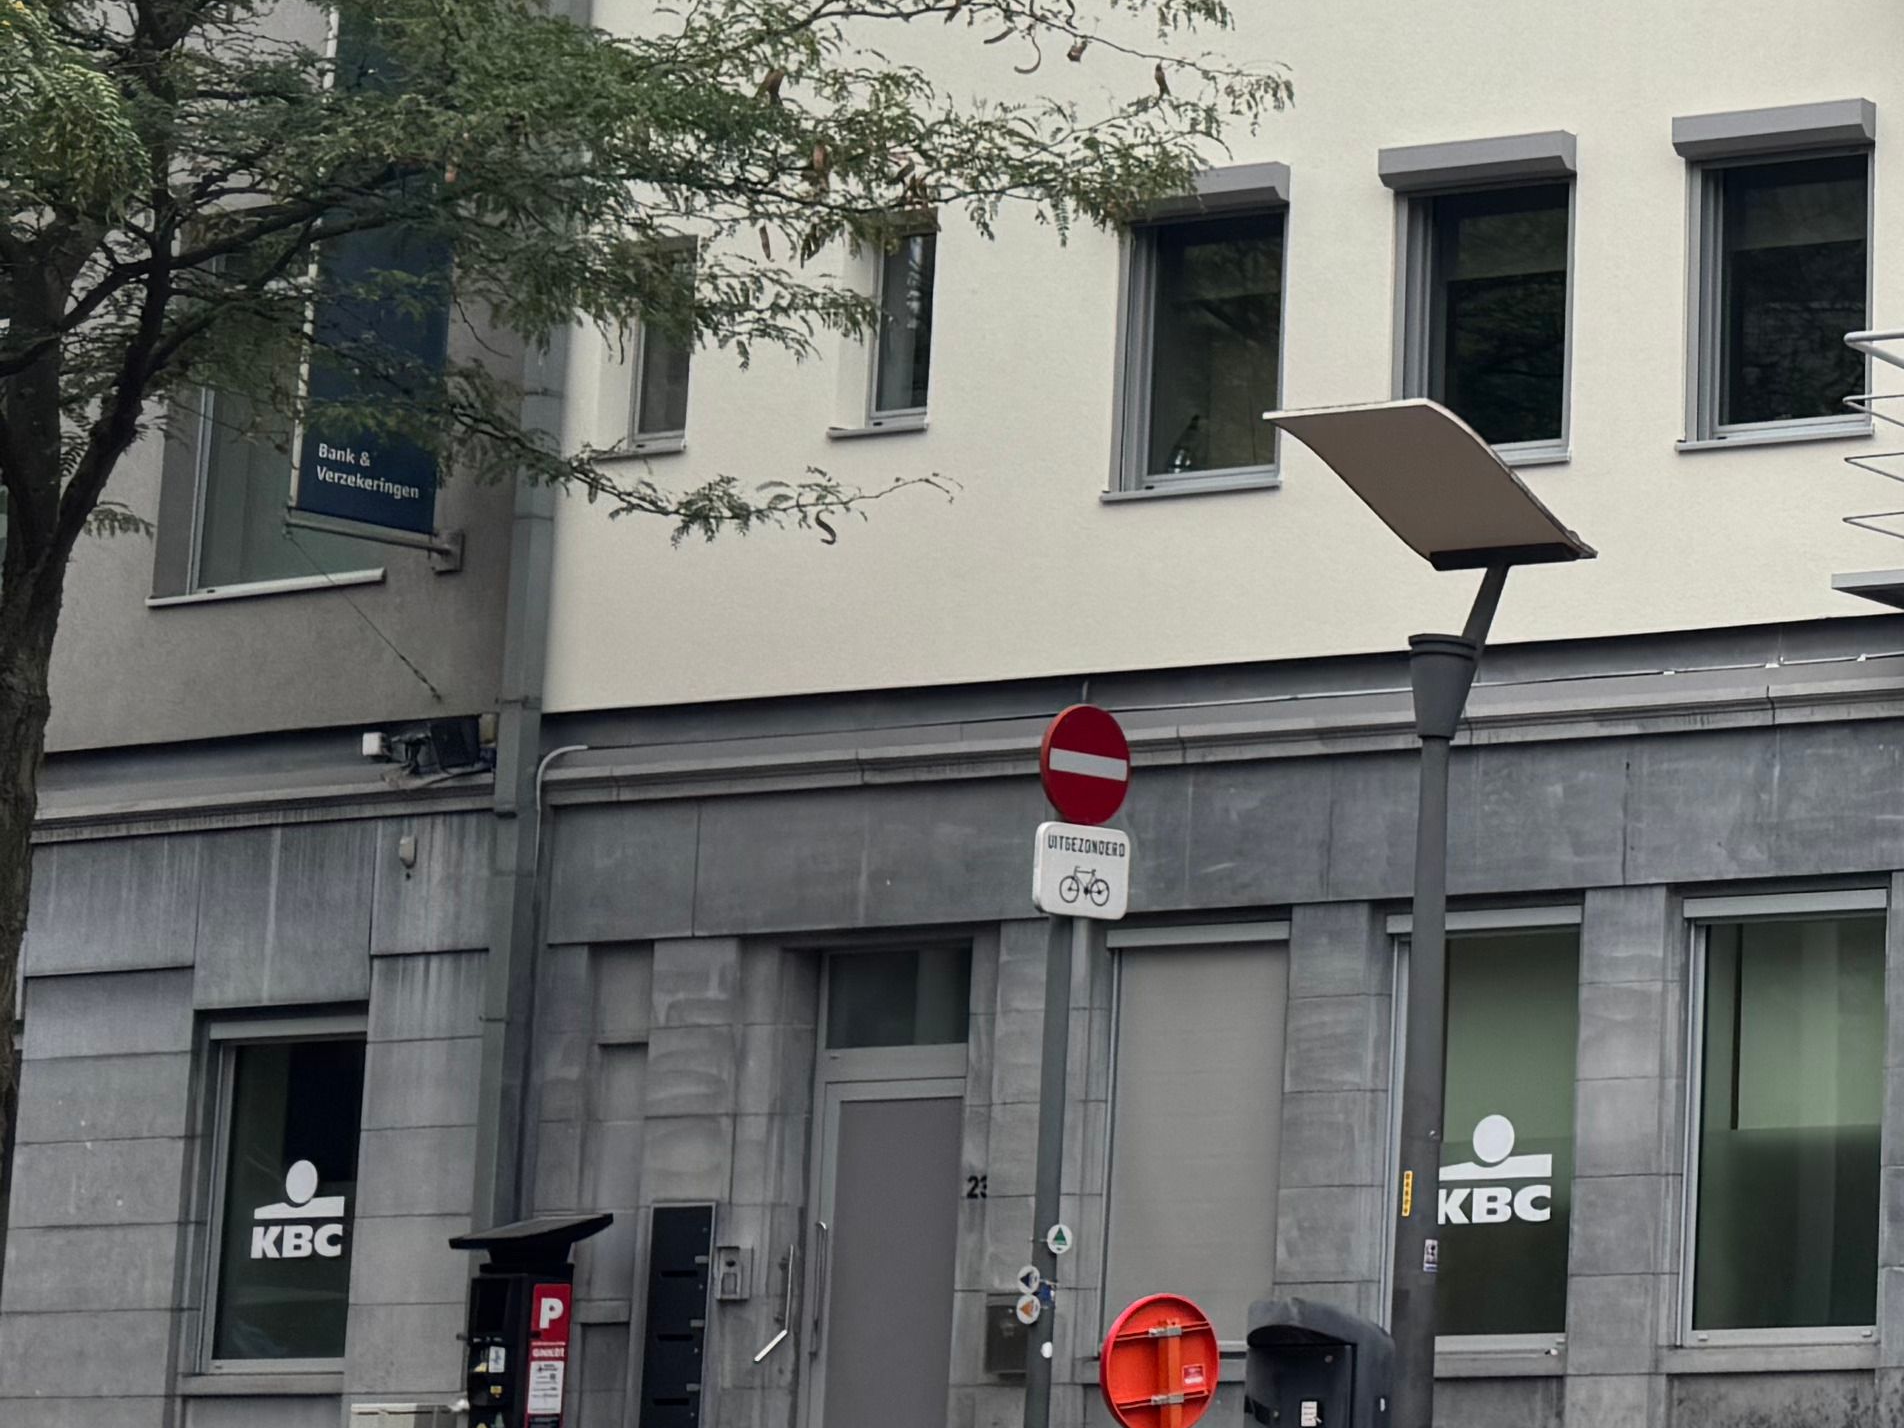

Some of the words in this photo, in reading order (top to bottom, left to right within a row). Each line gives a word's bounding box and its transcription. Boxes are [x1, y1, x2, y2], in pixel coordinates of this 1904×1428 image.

[318, 442, 355, 464] Bank
[359, 451, 371, 467] &
[316, 464, 419, 499] Verzekeringen
[1047, 834, 1126, 857] UITGEZONDERD
[1438, 1185, 1551, 1225] KBC
[250, 1224, 343, 1259] KBC
[540, 1297, 564, 1329] P
